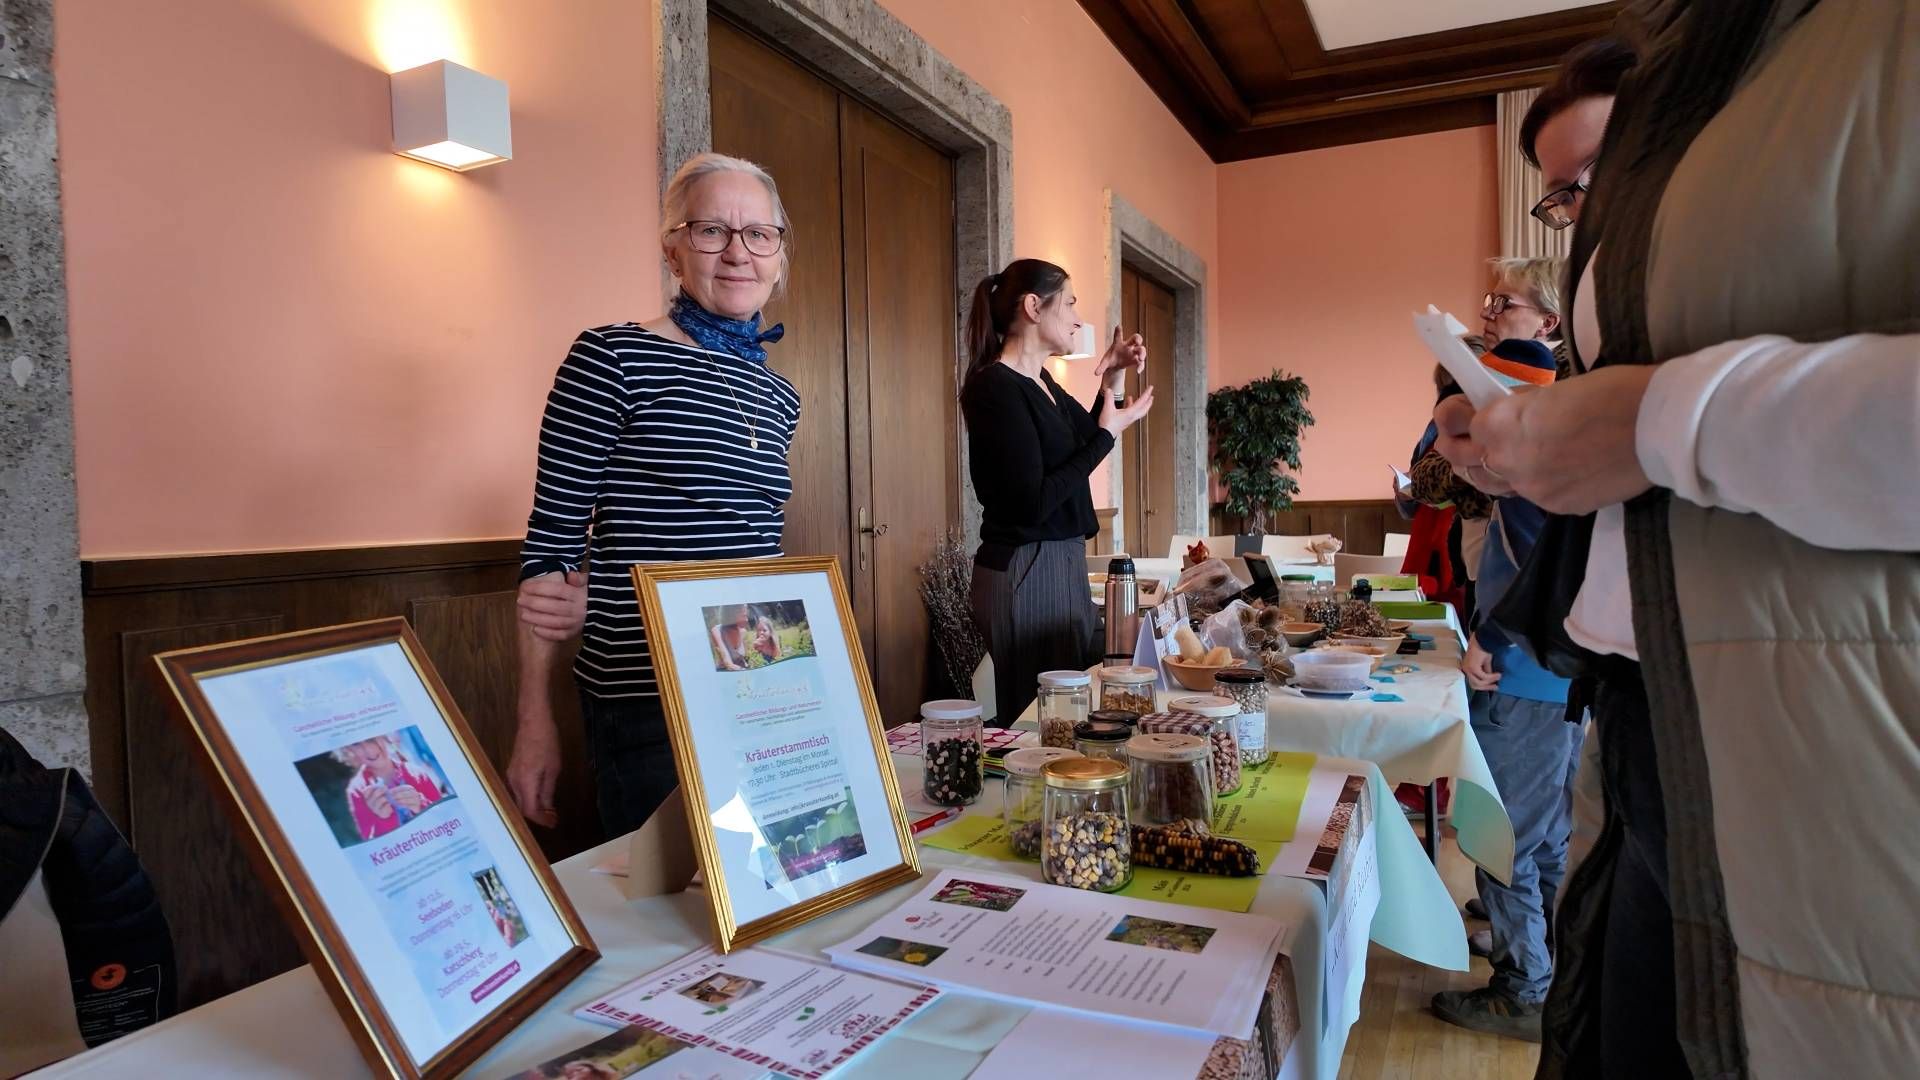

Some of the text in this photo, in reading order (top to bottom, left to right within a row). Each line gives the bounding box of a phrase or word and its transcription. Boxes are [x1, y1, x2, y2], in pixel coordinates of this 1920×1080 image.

[745, 734, 830, 763] Kräuterstammtisch
[776, 756, 803, 768] Dienstag
[369, 817, 462, 866] Kräuterführungen
